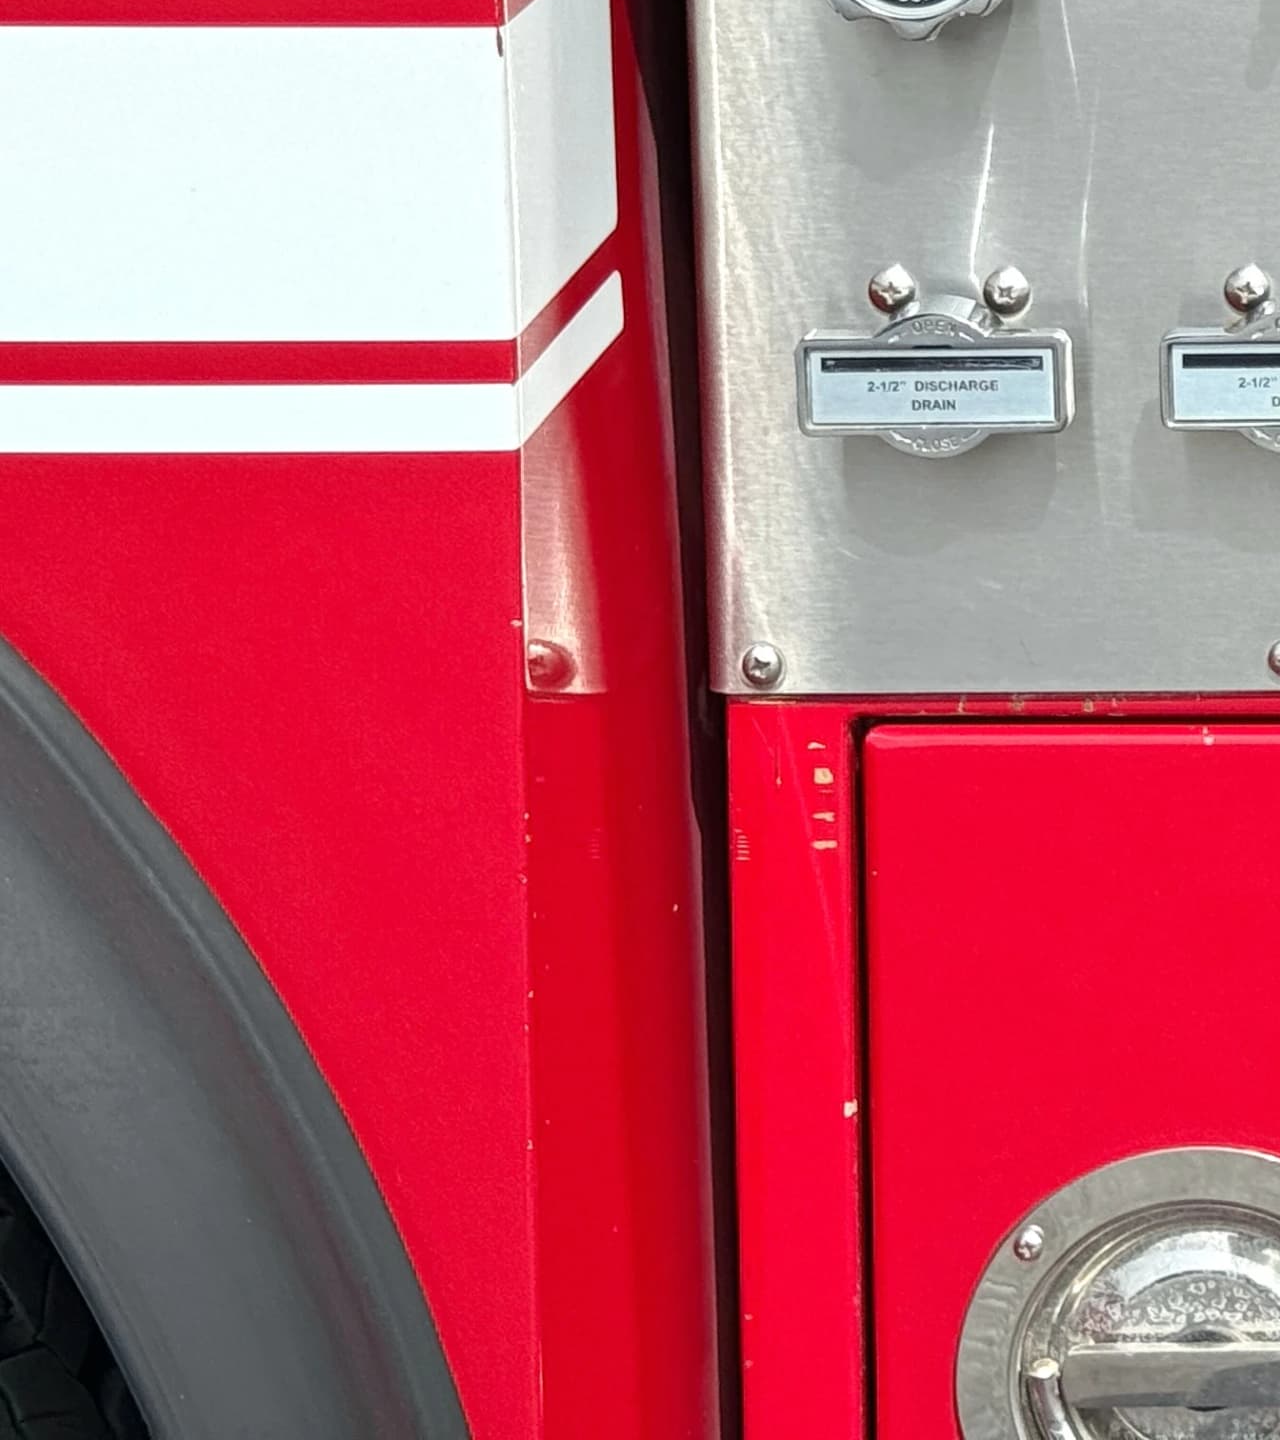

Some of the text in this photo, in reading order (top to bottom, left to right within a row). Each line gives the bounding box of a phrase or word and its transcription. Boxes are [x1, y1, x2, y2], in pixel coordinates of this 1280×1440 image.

[911, 320, 958, 336] OPEN
[914, 379, 999, 392] DISCHARGE
[911, 399, 957, 411] DRAIN
